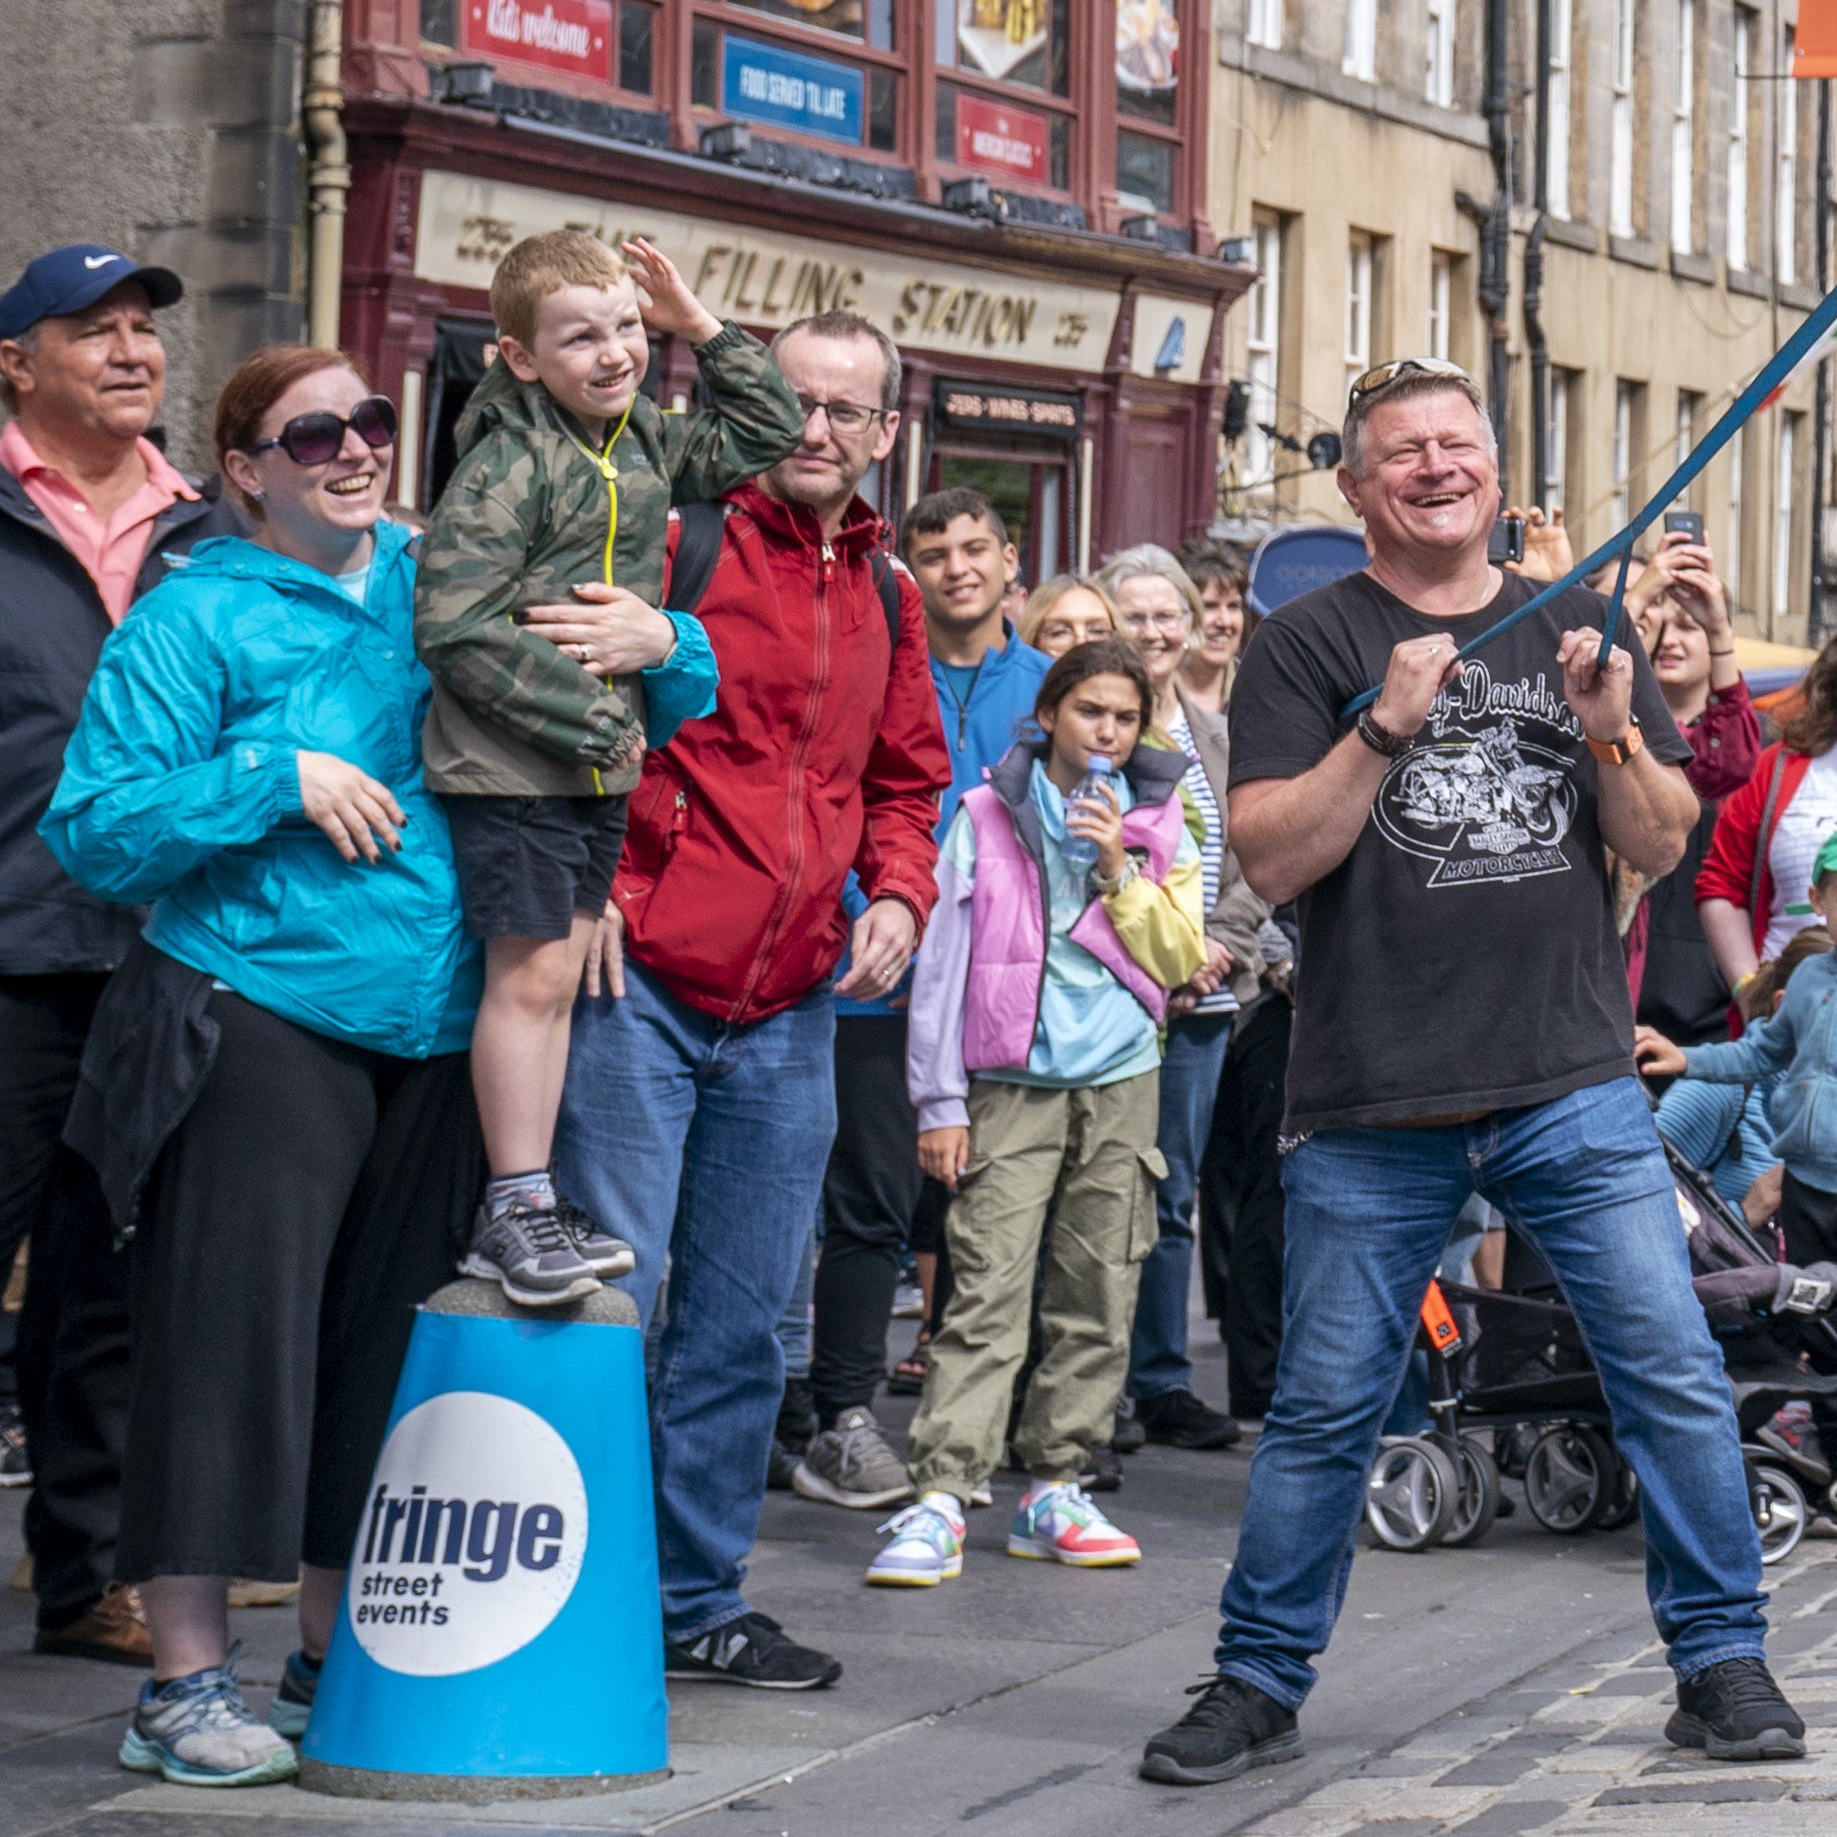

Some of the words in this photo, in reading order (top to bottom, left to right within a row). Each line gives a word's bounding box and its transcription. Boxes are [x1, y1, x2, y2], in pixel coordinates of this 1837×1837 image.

[521, 2, 591, 59] welcome
[767, 72, 806, 111] SERVED
[693, 242, 864, 313] FILLING
[892, 277, 1038, 348] STATION
[361, 1483, 565, 1583] fringe
[361, 1571, 443, 1597] street
[356, 1600, 449, 1626] events
